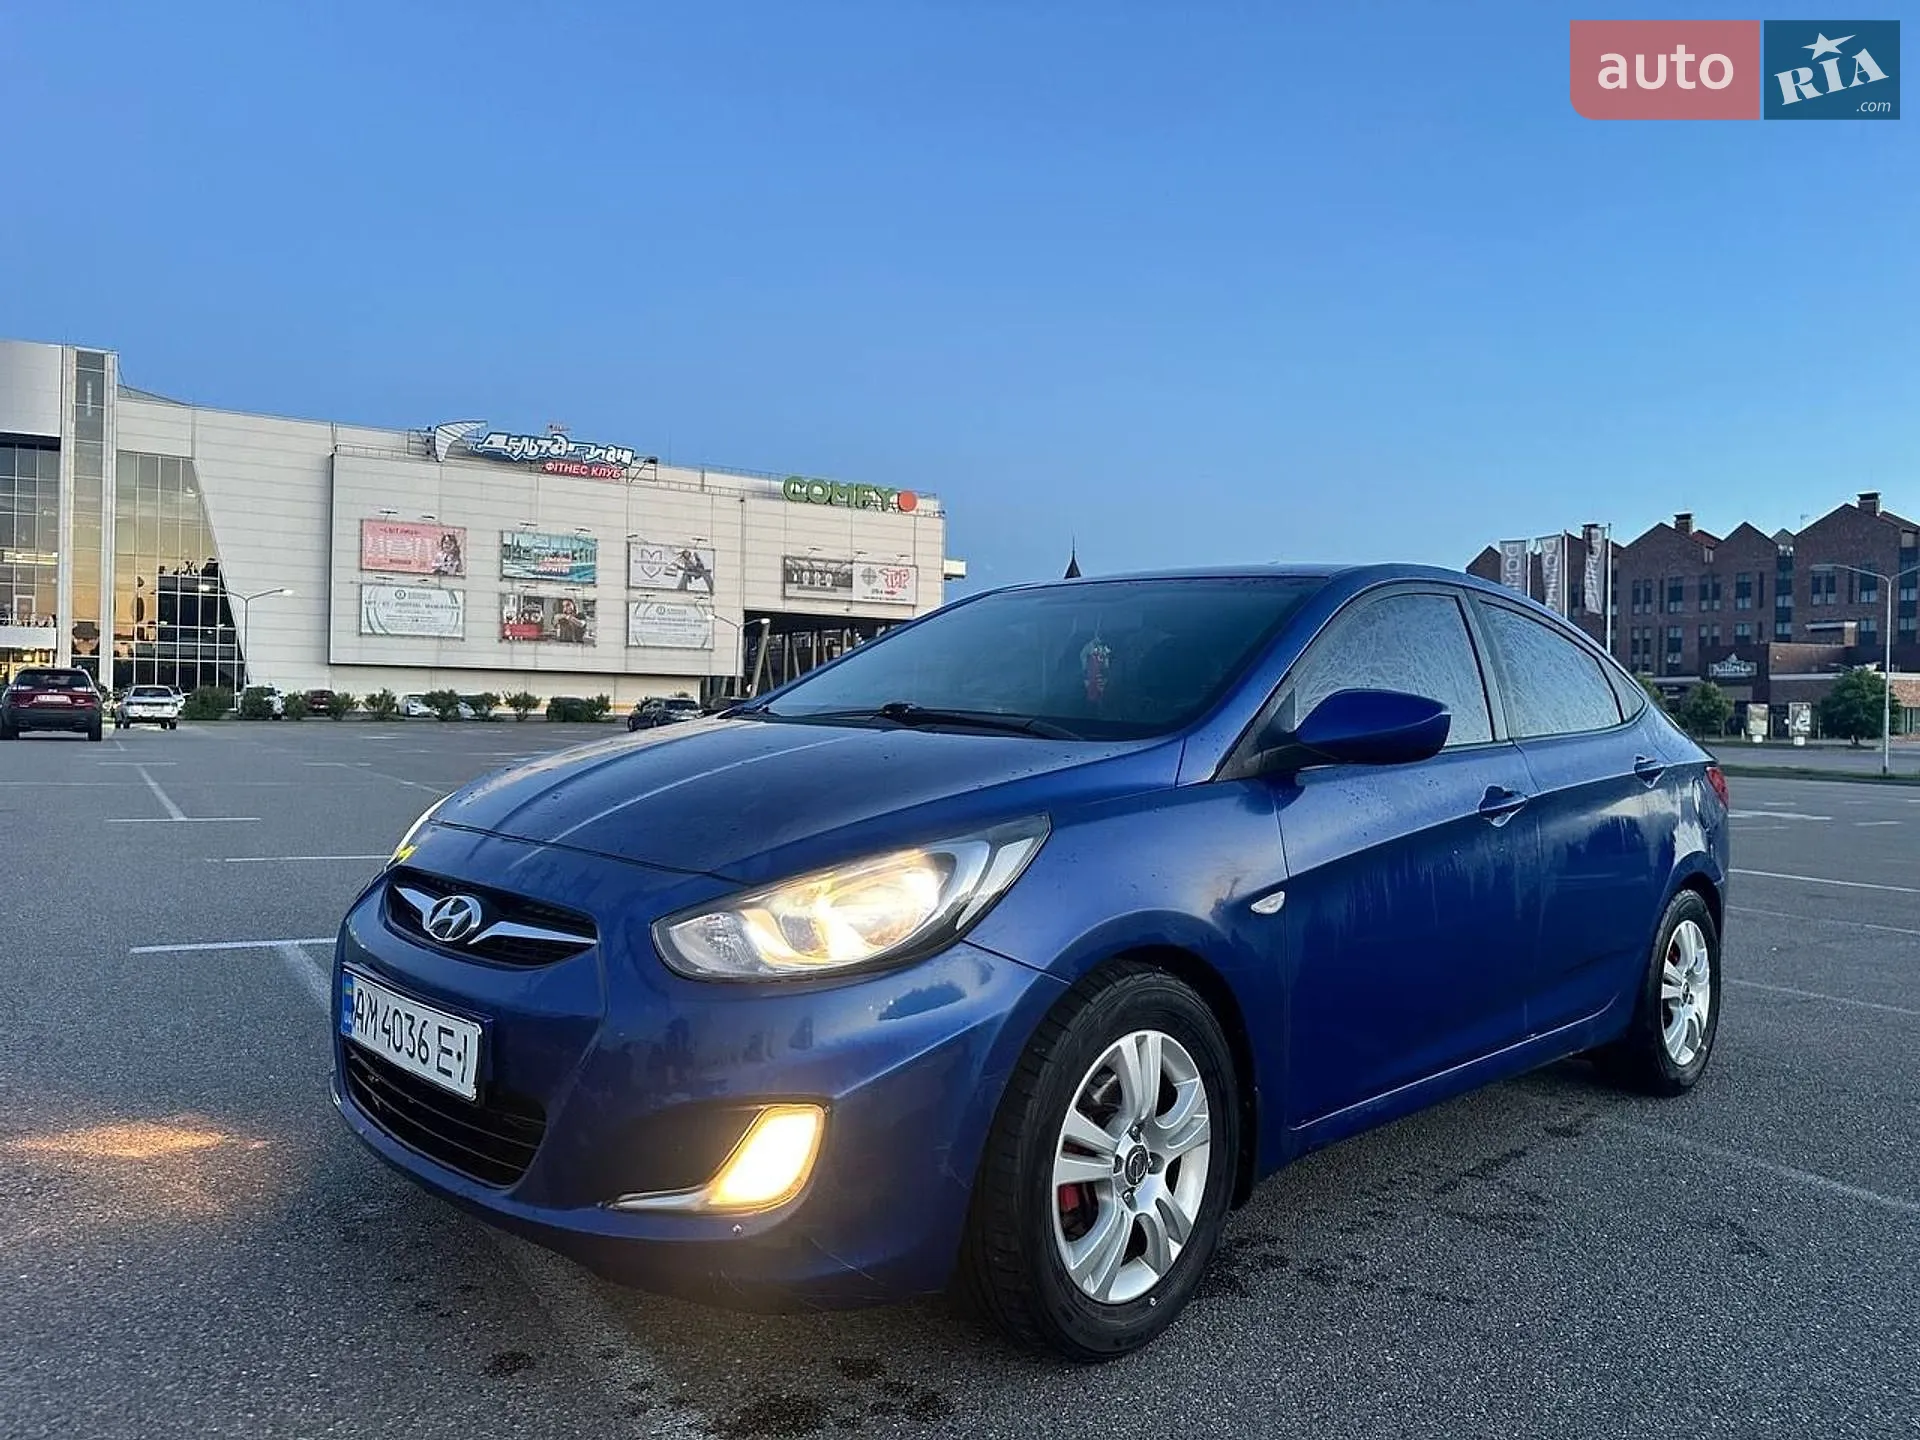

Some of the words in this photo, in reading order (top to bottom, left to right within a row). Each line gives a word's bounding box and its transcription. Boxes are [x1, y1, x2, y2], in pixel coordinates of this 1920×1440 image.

[545, 461, 589, 476] ФІТНЕС
[590, 467, 621, 479] КЛУБ
[783, 475, 898, 512] COMFY
[354, 987, 378, 1041] AM
[381, 1004, 430, 1065] 4036
